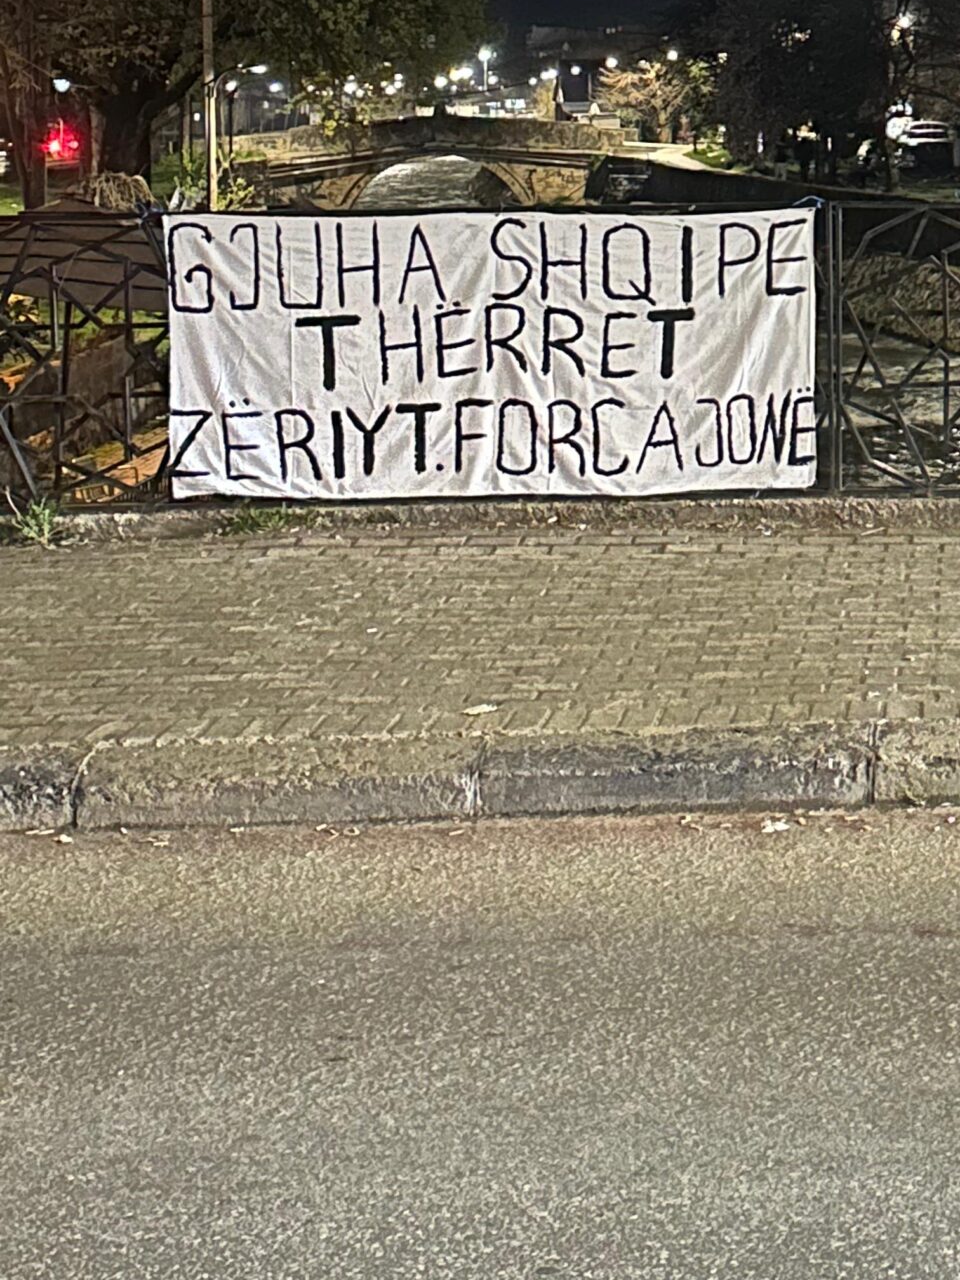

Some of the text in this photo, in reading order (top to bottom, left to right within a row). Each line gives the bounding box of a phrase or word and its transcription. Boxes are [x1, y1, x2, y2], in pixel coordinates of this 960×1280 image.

[168, 218, 808, 313] GJUHA SHQIPE
[295, 302, 696, 391] THËRRET
